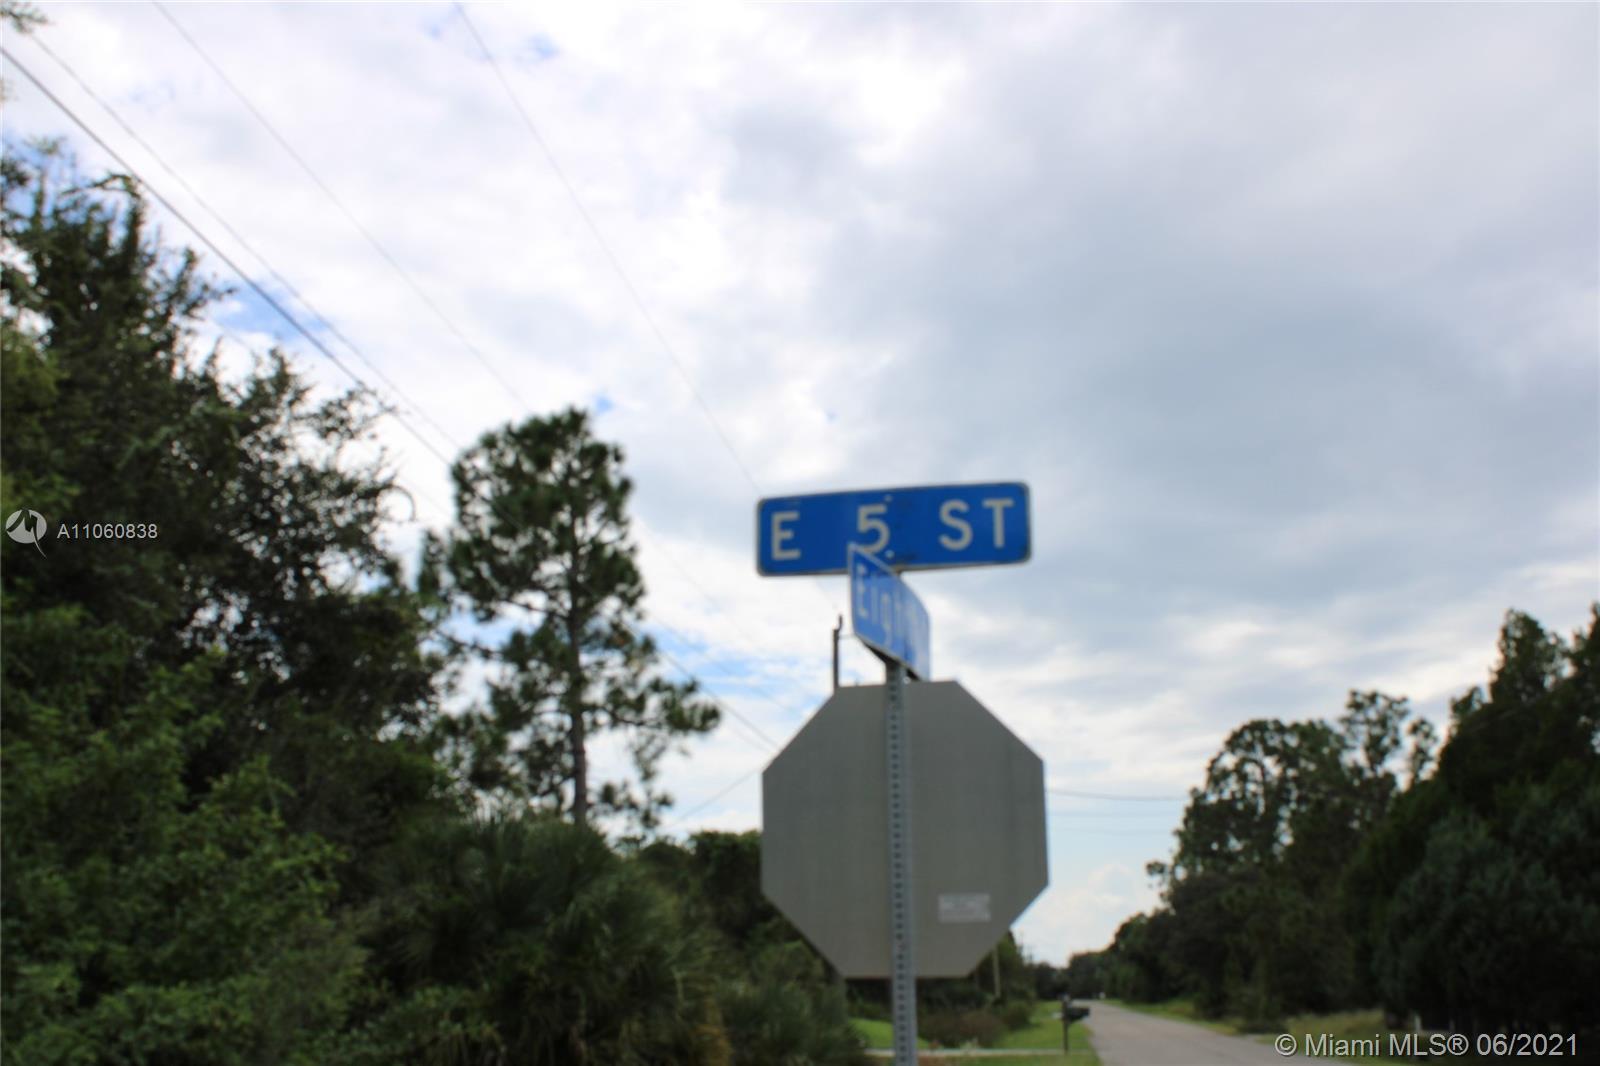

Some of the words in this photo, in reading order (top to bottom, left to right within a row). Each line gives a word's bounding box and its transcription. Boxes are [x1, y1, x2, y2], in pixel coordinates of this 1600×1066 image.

[771, 511, 801, 560] E
[857, 504, 890, 554] 5
[938, 498, 1014, 551] ST
